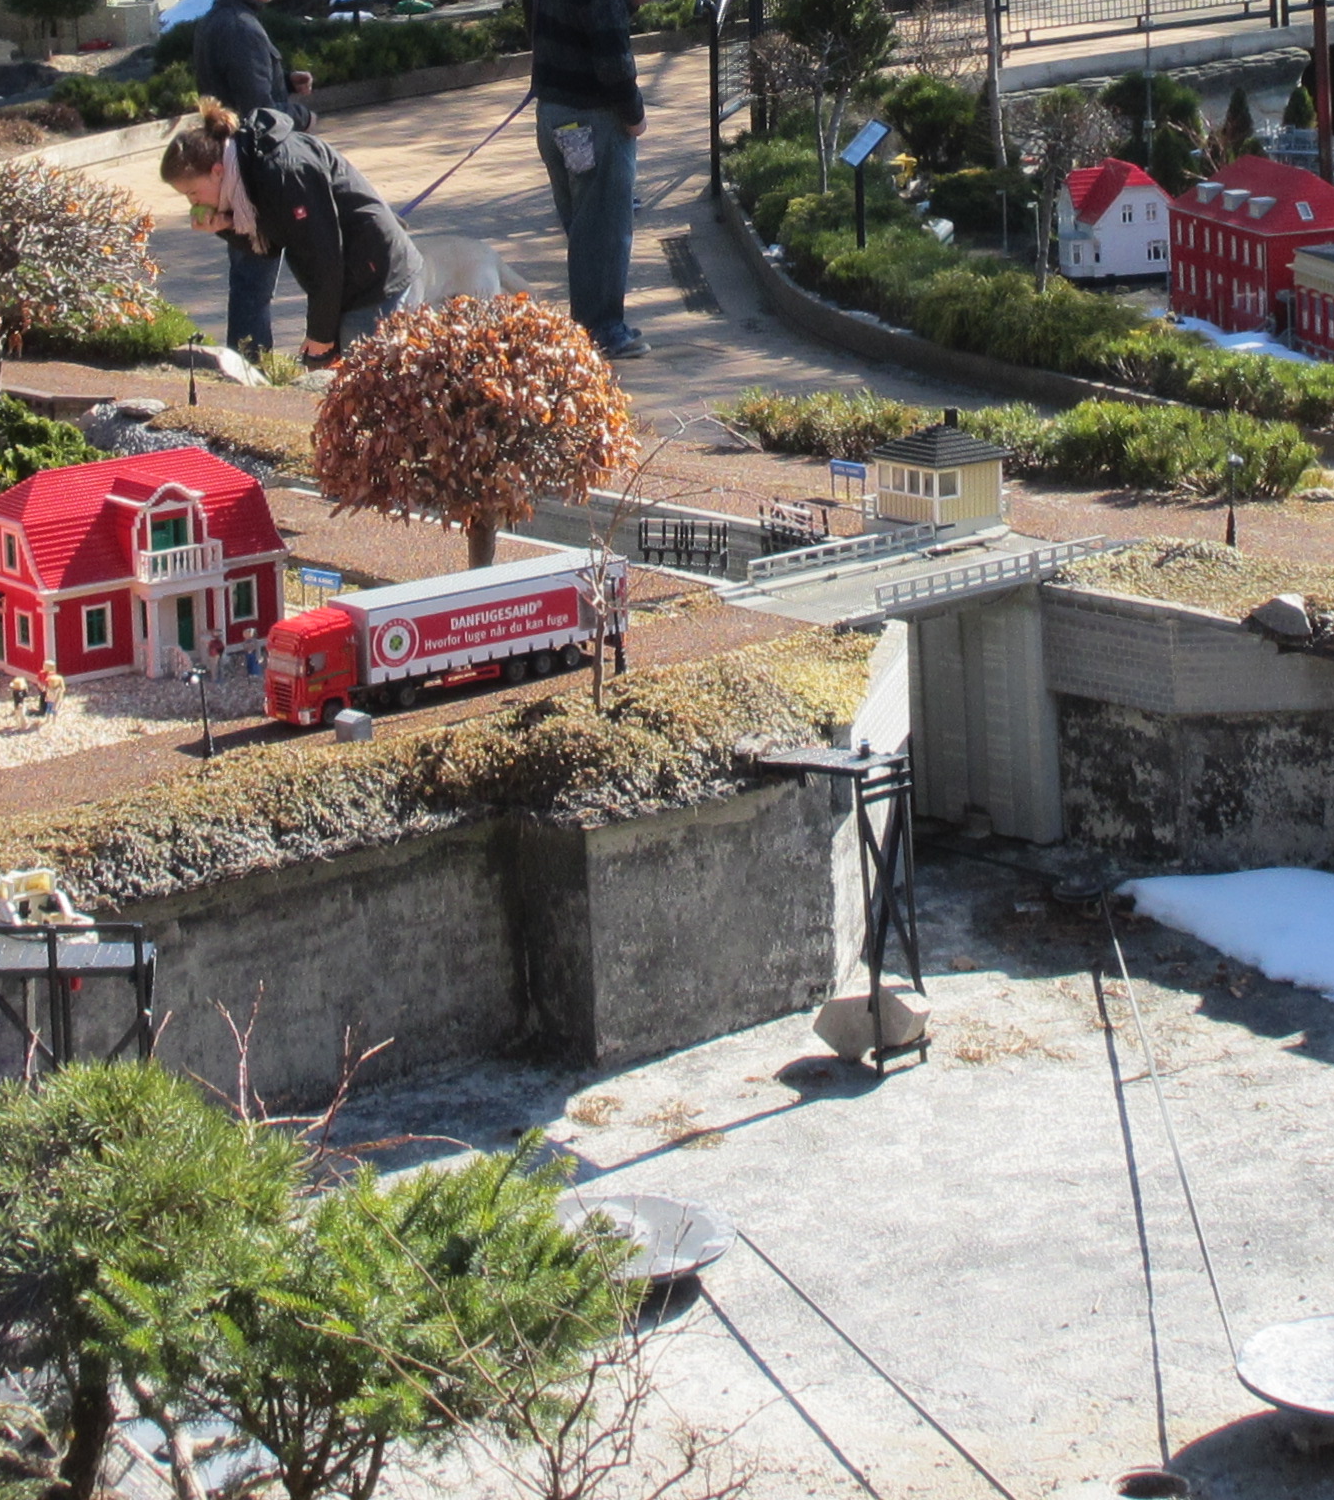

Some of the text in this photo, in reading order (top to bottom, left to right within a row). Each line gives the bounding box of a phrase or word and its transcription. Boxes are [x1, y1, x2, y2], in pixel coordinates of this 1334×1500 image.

[424, 613, 569, 651] Hvorfor luge når du kan fuge
